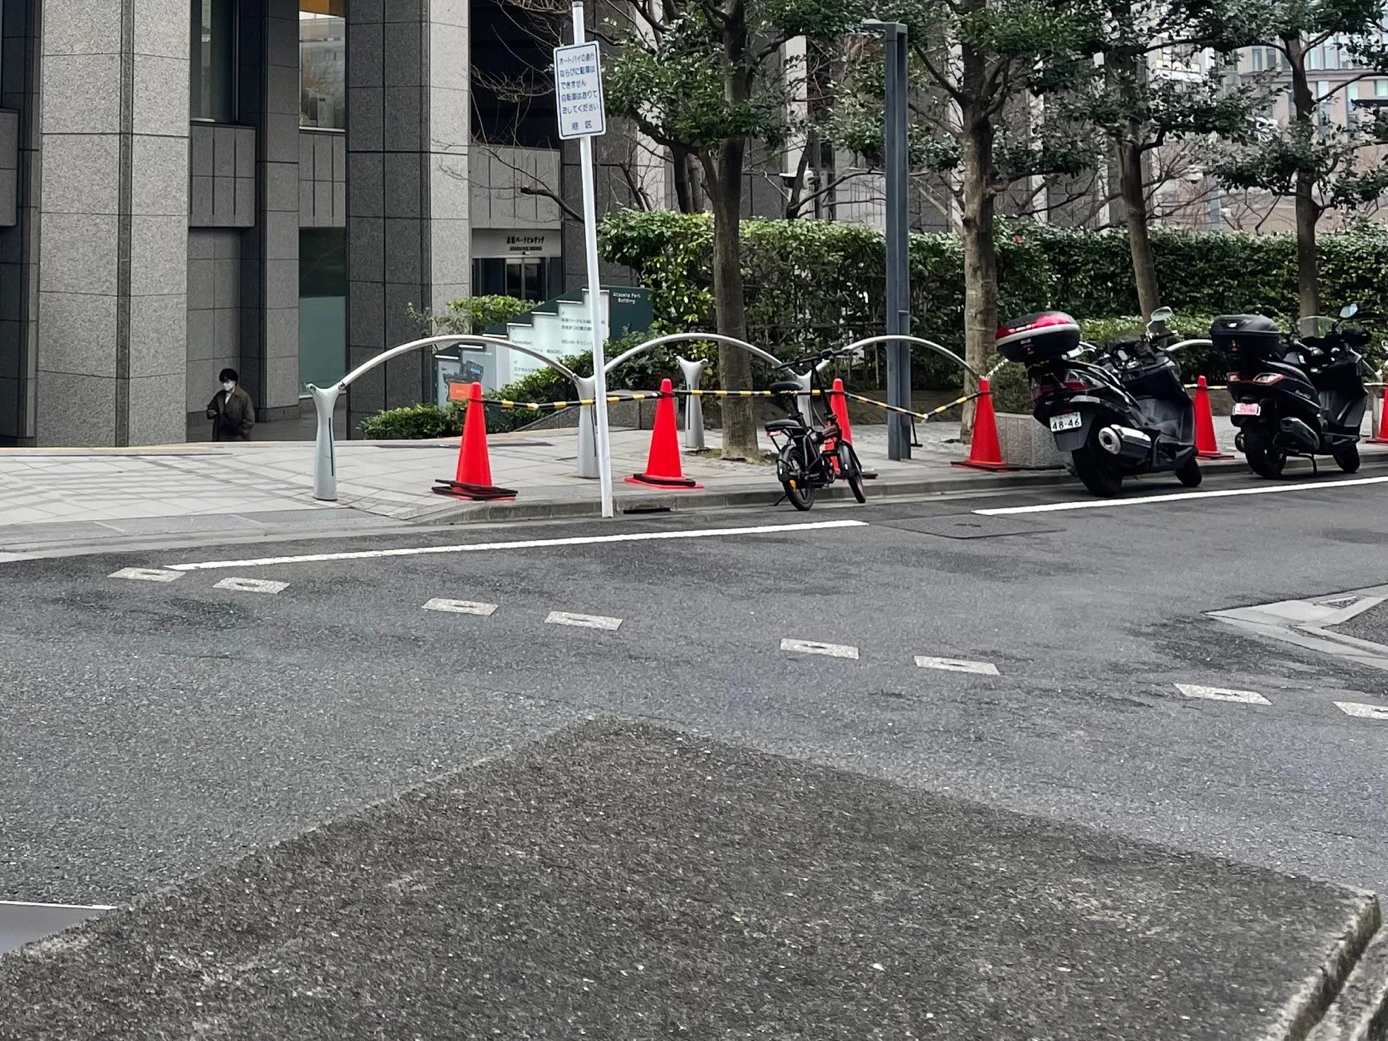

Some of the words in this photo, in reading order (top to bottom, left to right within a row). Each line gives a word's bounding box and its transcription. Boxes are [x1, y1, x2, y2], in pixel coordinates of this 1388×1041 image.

[560, 79, 587, 89] できません
